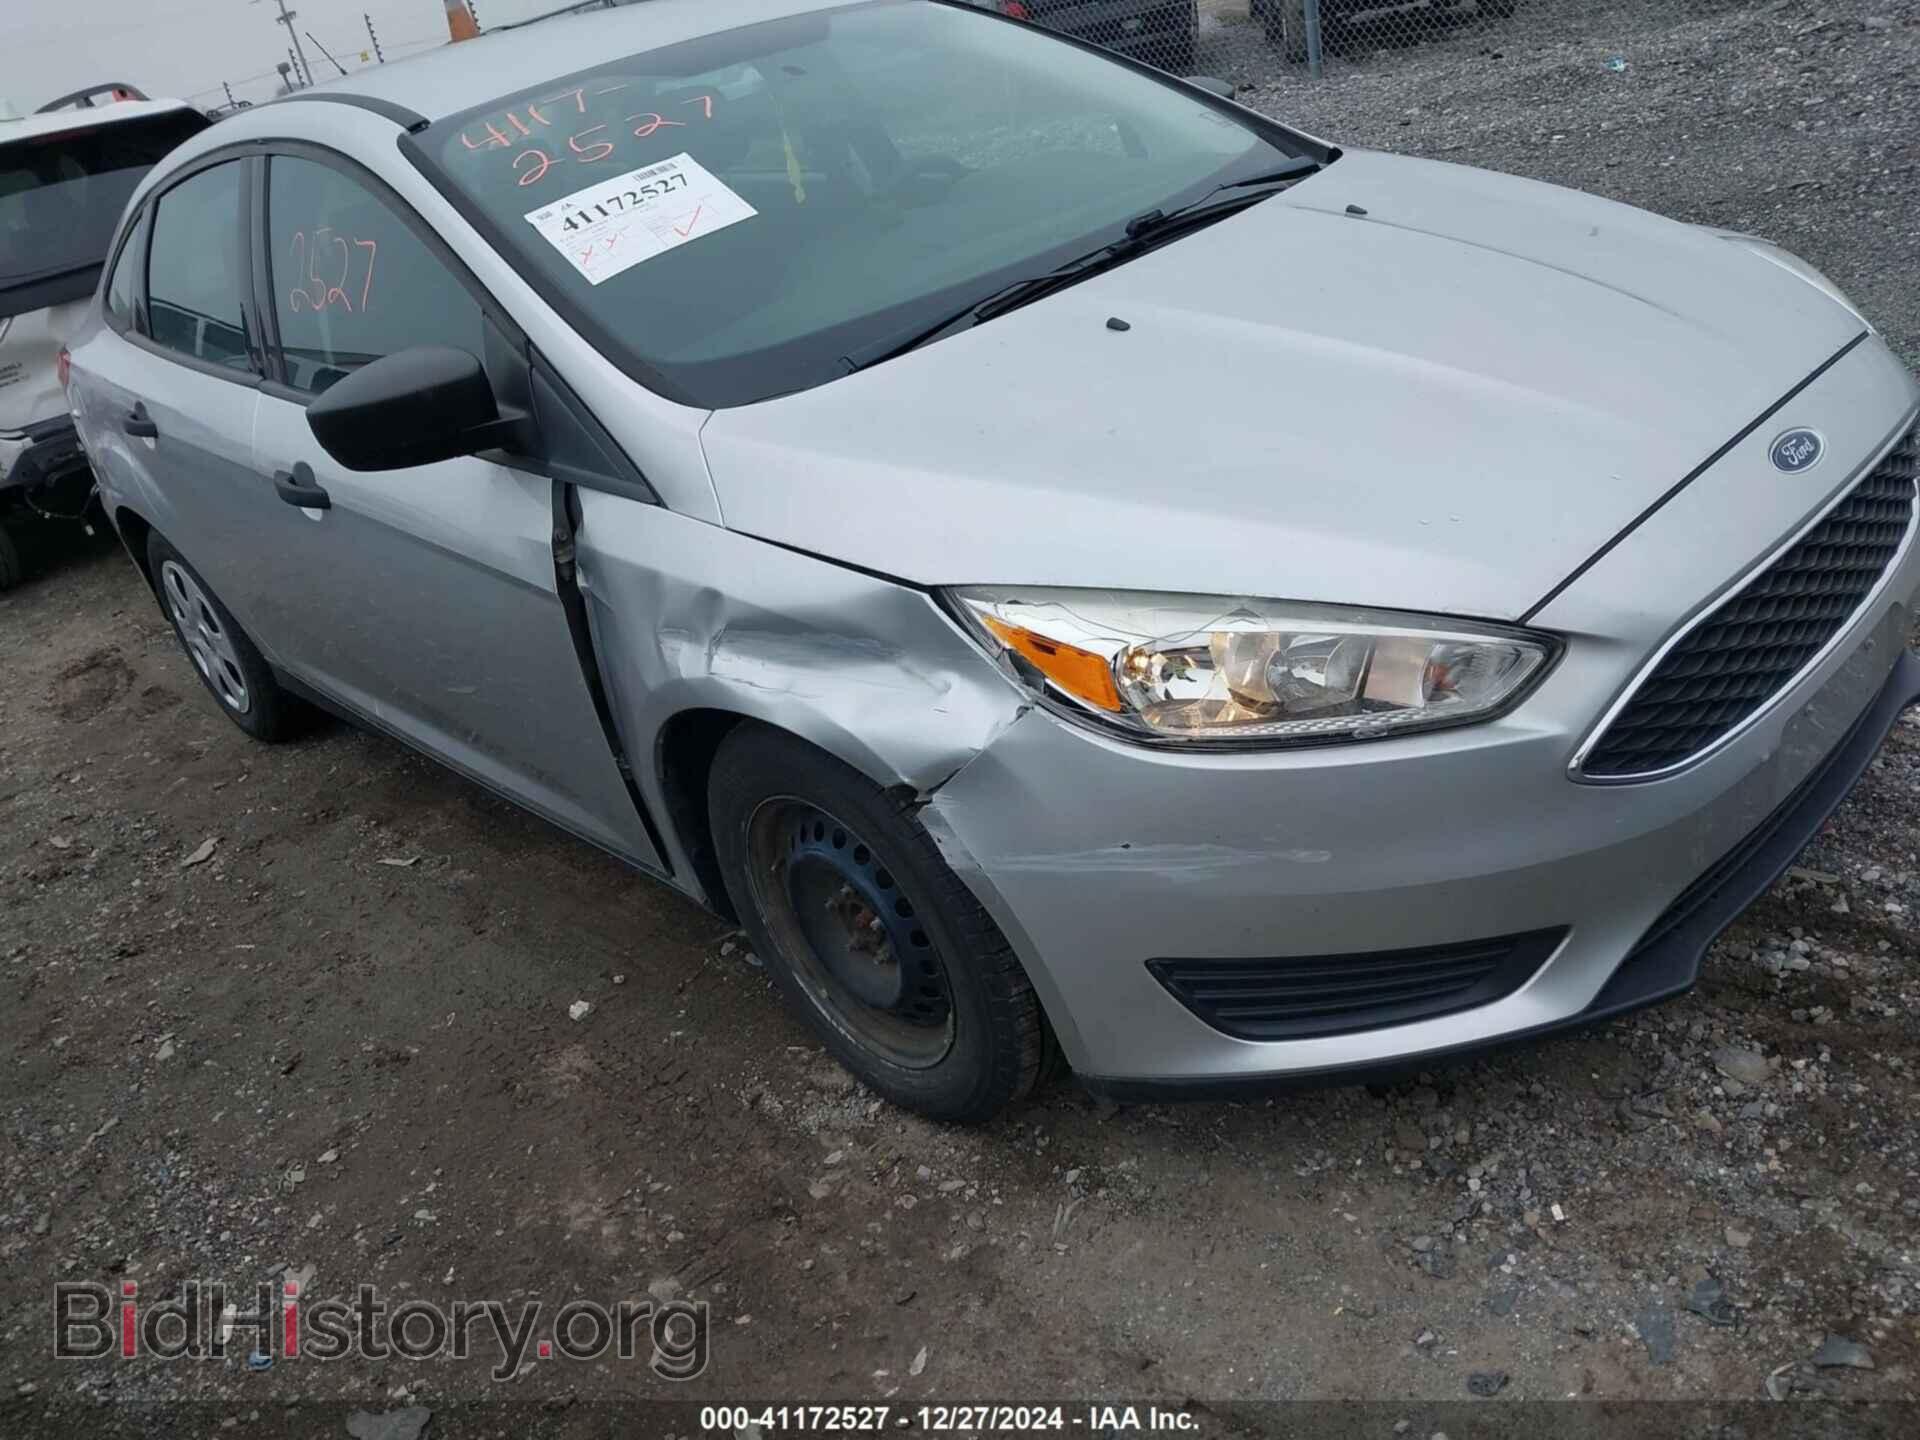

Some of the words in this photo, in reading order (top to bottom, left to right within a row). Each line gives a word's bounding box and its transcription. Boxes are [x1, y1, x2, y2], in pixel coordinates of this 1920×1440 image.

[512, 95, 712, 186] 2527
[562, 172, 688, 232] 41172527
[288, 227, 377, 313] 2527
[1781, 436, 1815, 466] Ford
